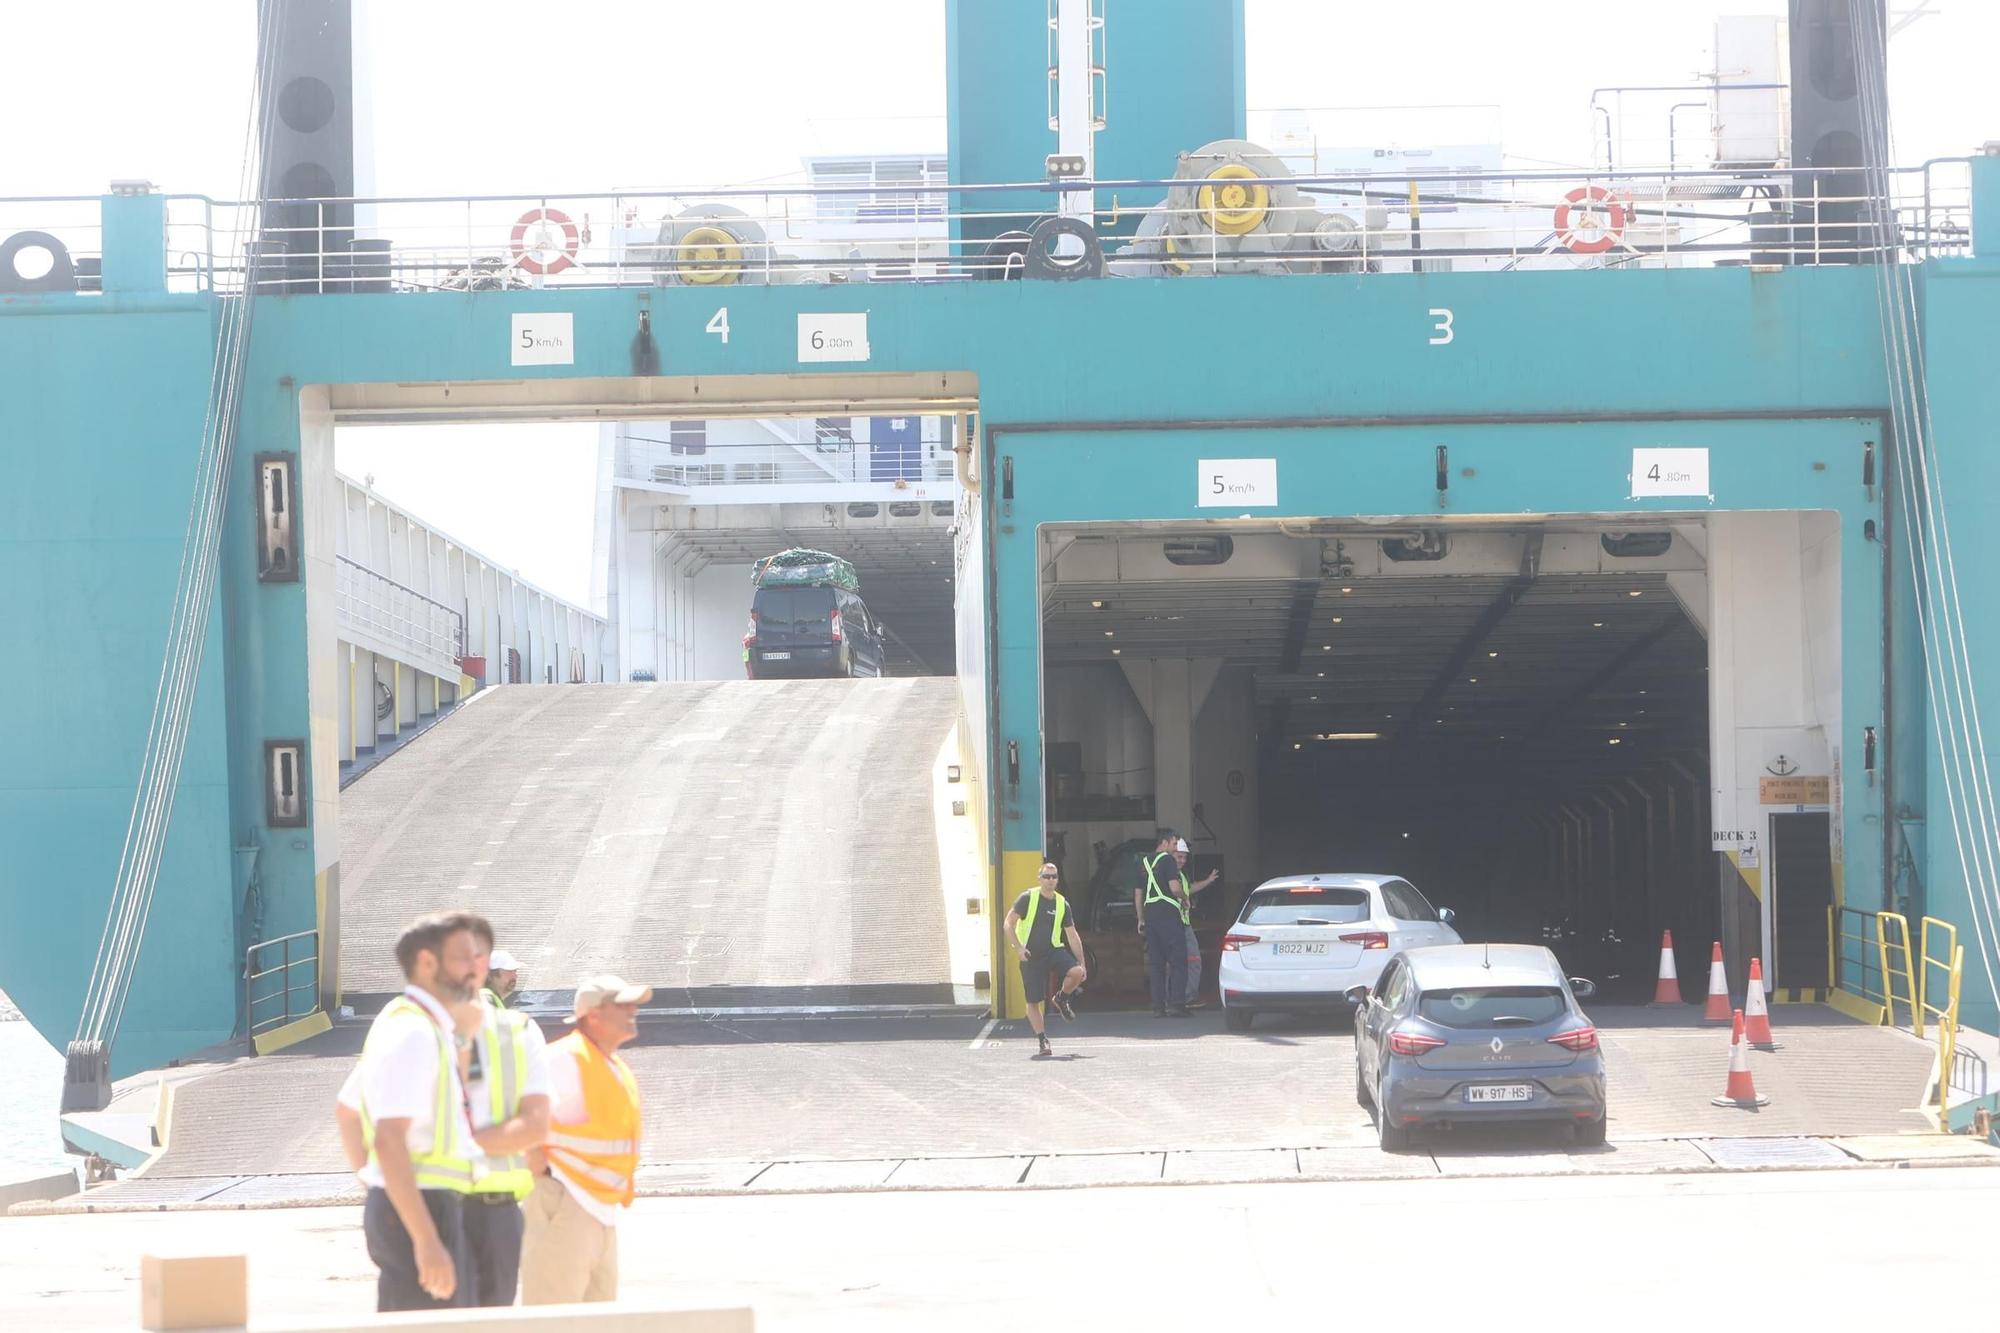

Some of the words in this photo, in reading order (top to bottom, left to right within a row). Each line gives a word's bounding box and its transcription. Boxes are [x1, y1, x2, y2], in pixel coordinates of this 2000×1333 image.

[705, 307, 730, 343] 4
[1429, 308, 1454, 344] 3
[521, 329, 534, 348] 5
[536, 336, 562, 347] Km/h
[1213, 475, 1225, 494] 5
[1228, 483, 1255, 494] Km/h
[1713, 831, 1745, 841] DECK
[1749, 831, 1757, 841] 3
[1278, 943, 1303, 954] 8022
[1305, 943, 1325, 954] MJZ
